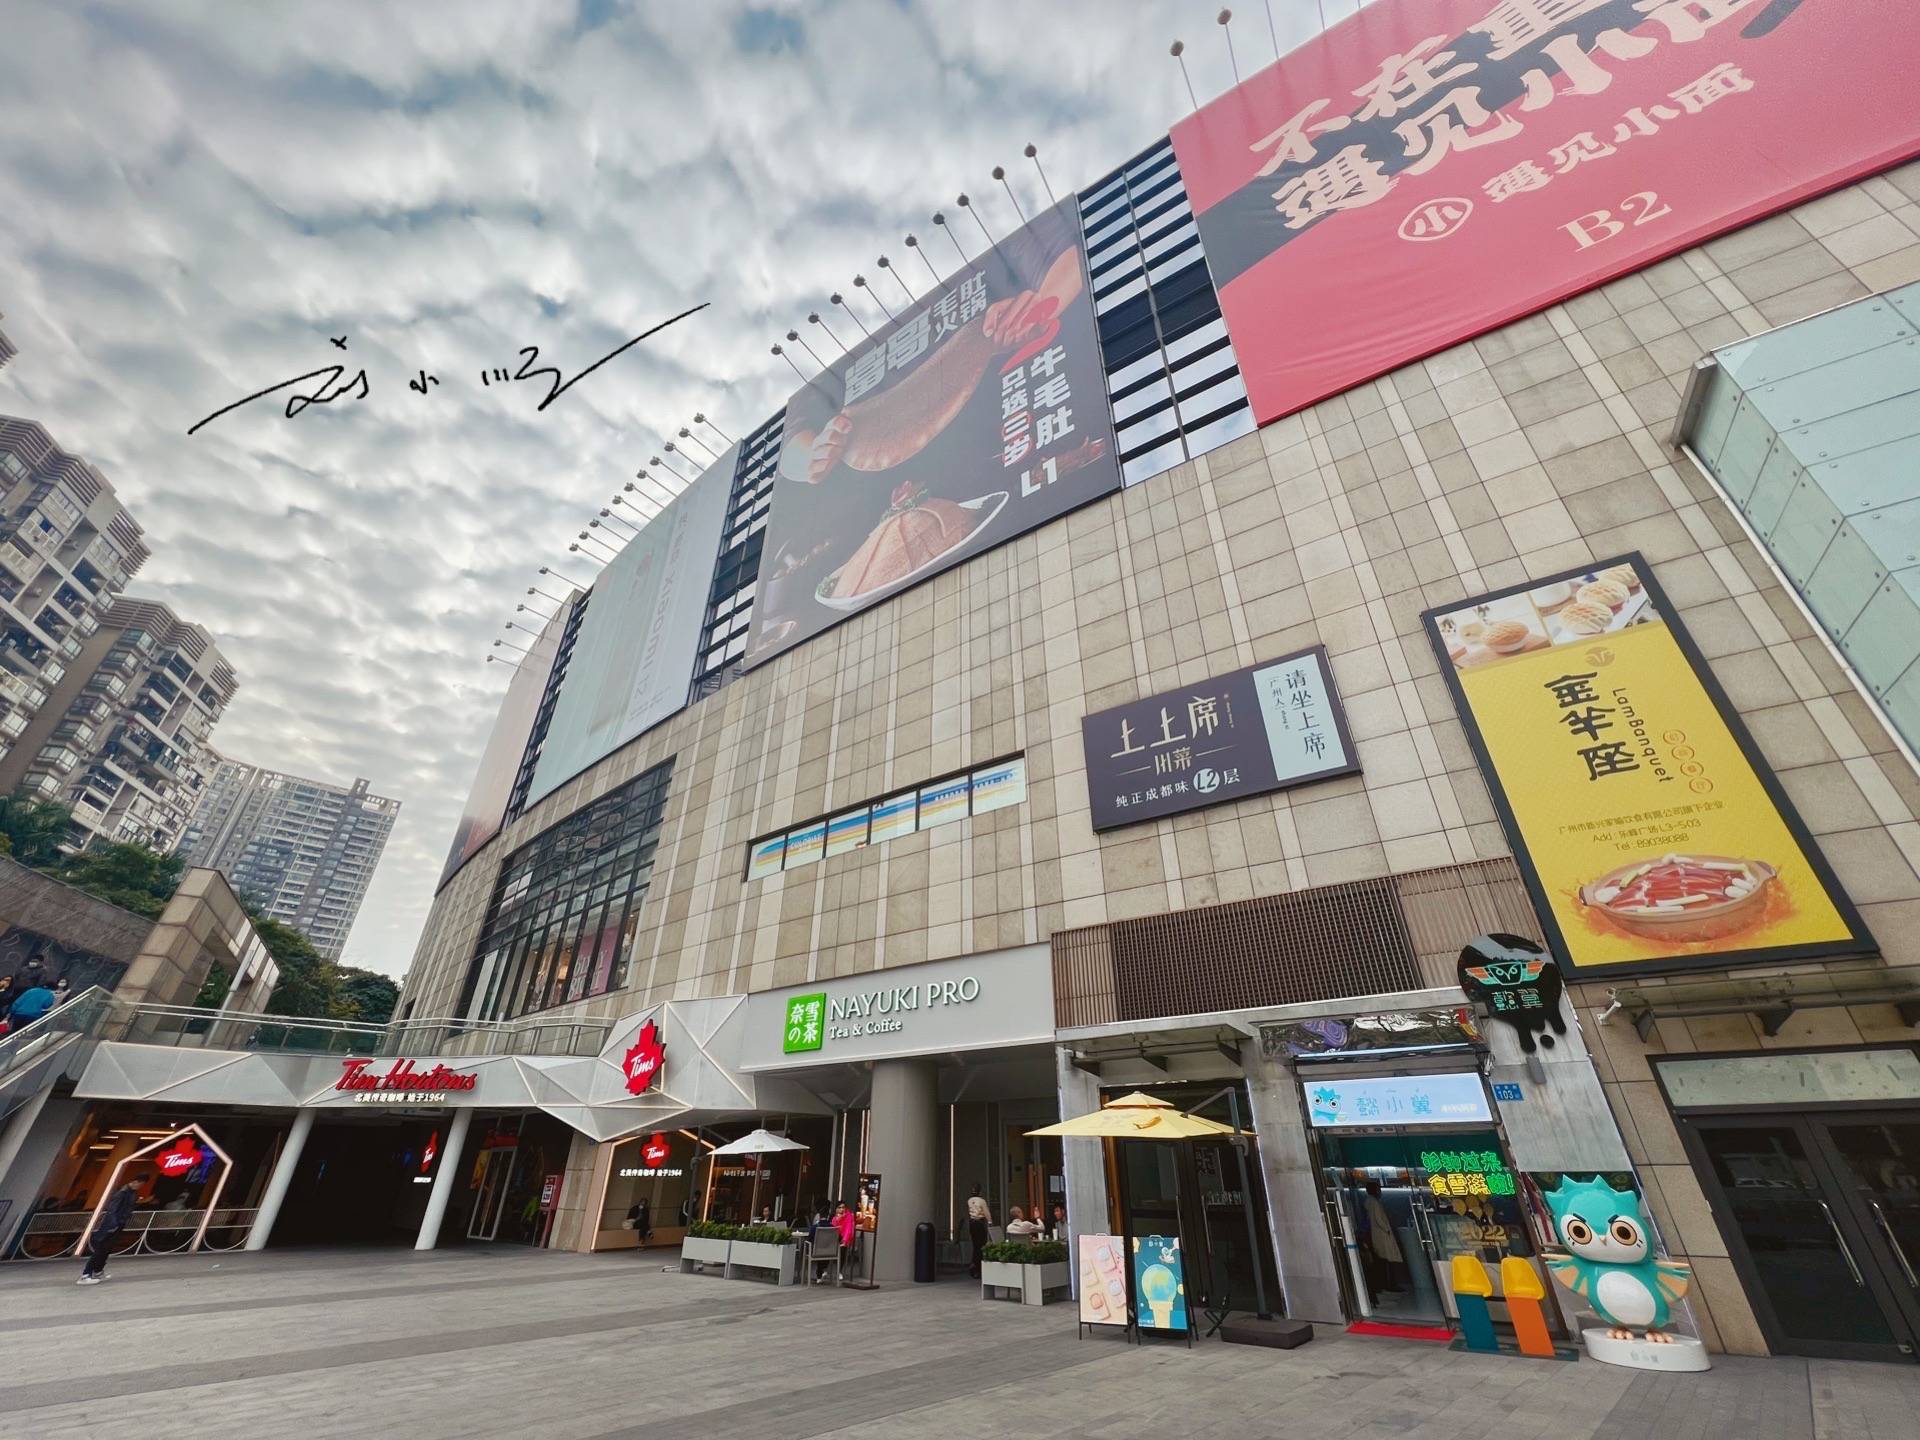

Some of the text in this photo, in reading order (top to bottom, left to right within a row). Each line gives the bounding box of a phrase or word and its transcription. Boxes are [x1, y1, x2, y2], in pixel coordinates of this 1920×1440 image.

[1481, 62, 1755, 203] 遇见小面
[1556, 190, 1672, 252] B2
[1001, 366, 1030, 468] 只选三岁
[1030, 345, 1075, 450] 牛毛肚
[1020, 456, 1058, 498] L1
[1110, 695, 1220, 759] 上上席
[1286, 668, 1327, 761] 请坐上席
[1612, 687, 1674, 782] LamBanquet
[1115, 768, 1241, 808] 纯正成都味 L2 层
[789, 1000, 821, 1025] 奈雪
[829, 976, 980, 1022] NAYUKI PRO
[787, 1022, 819, 1044] の茶
[829, 1017, 904, 1040] Tea & Coffee
[335, 1057, 479, 1091] Tim Hortons
[629, 1052, 656, 1079] Tims
[164, 1153, 195, 1169] Tims
[646, 1146, 665, 1160] Tims
